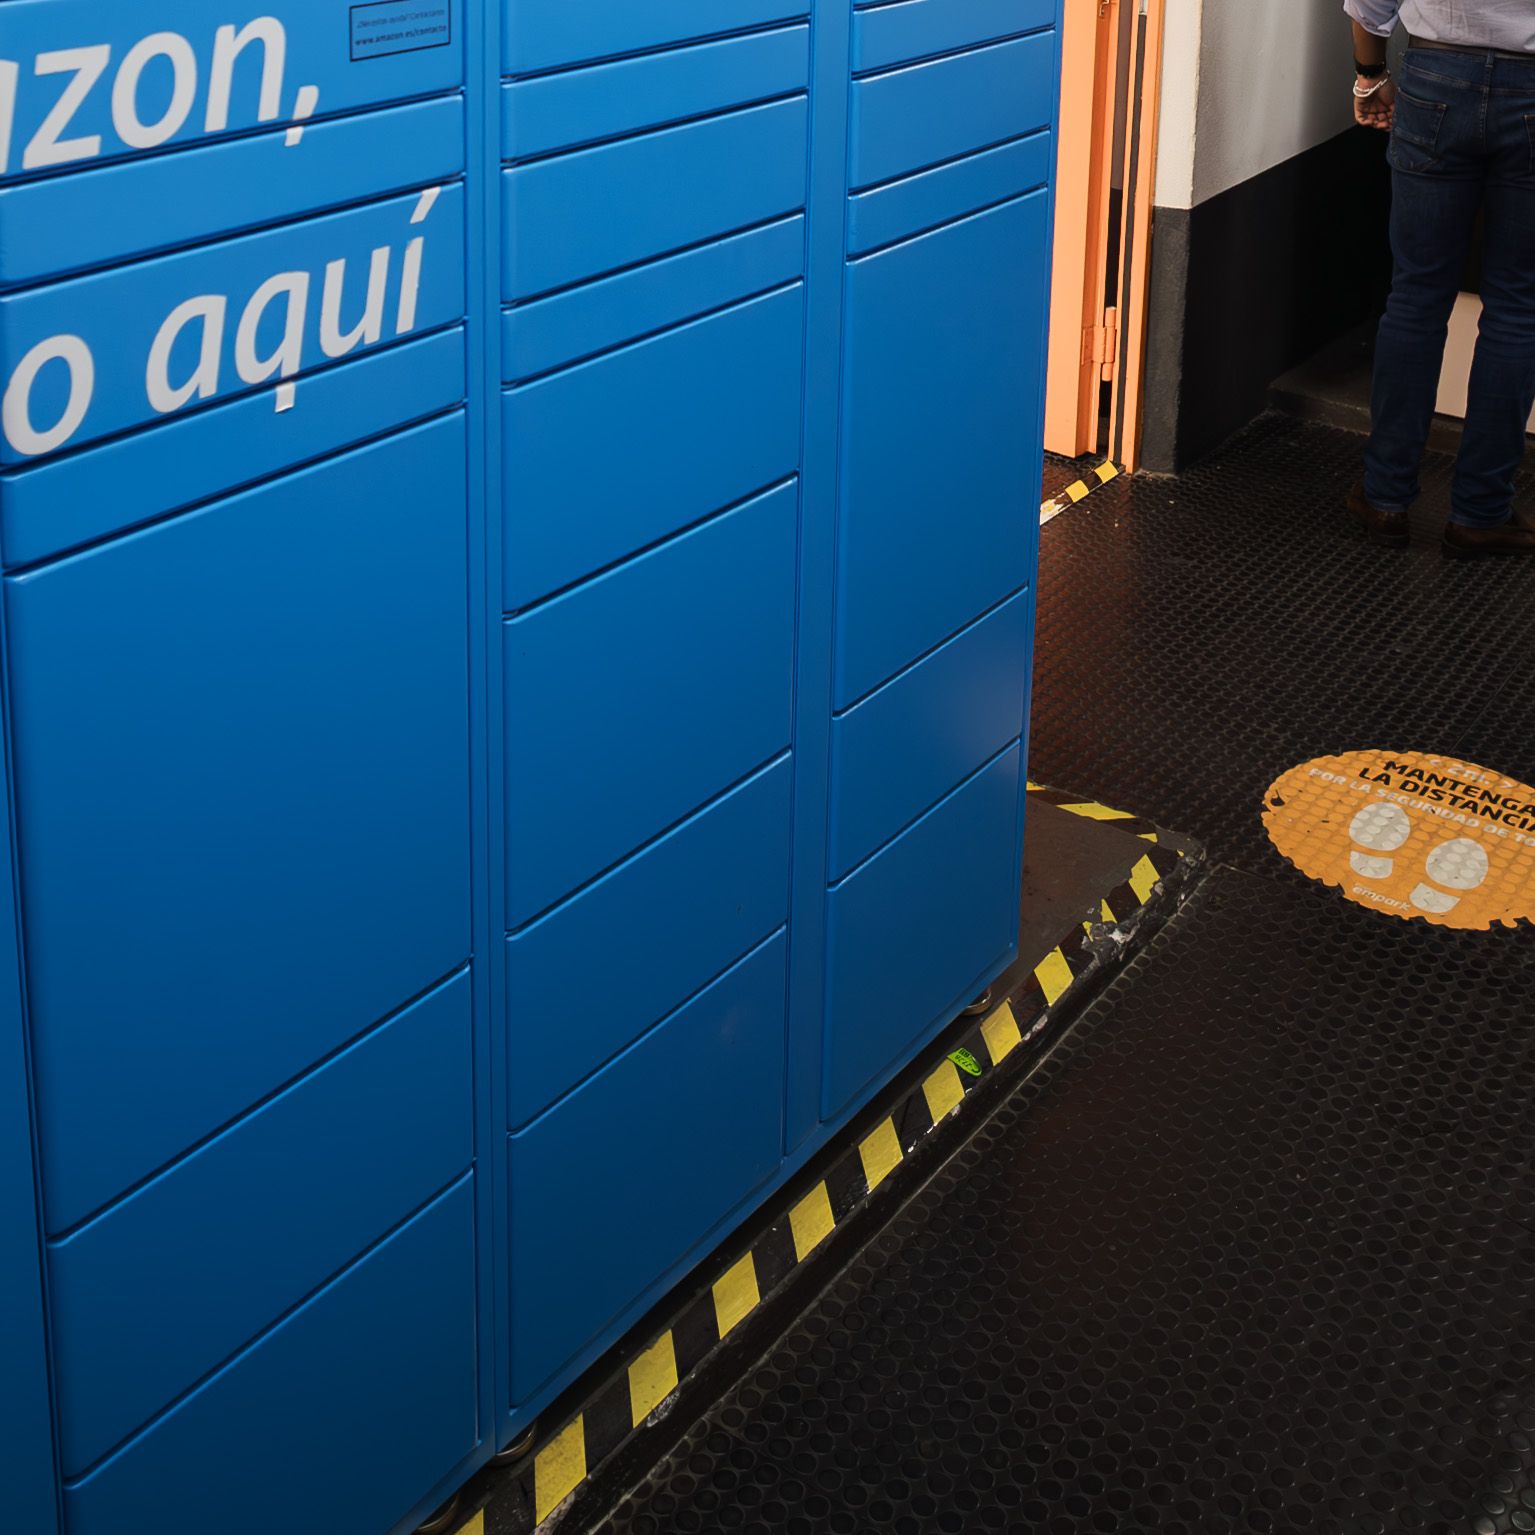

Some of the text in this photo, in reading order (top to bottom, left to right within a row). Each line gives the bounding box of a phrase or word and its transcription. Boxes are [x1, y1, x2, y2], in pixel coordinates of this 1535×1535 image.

[147, 187, 442, 412] aquí
[1358, 767, 1391, 786] LA
[1308, 767, 1347, 785] POR
[1349, 777, 1371, 794] LA
[1376, 787, 1480, 829] SEGURIDAD
[1483, 823, 1510, 838] DE
[1352, 883, 1411, 911] empark
